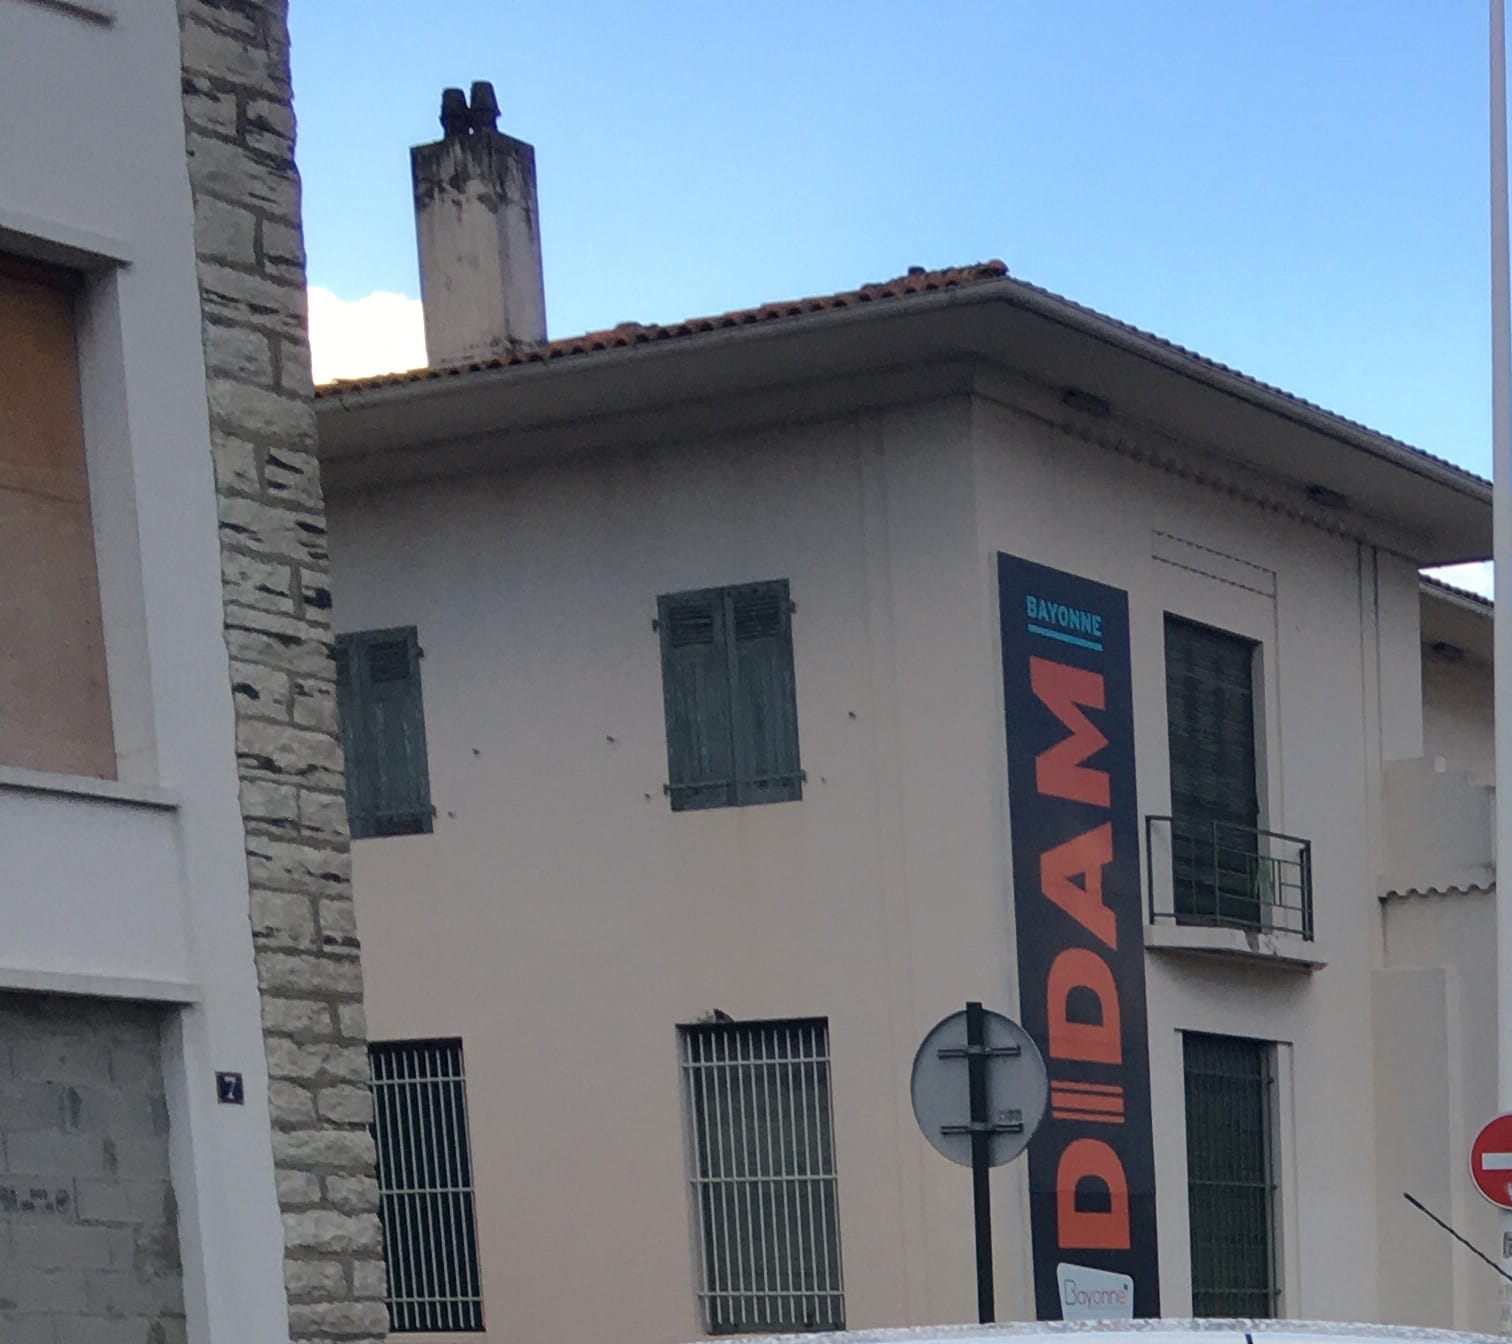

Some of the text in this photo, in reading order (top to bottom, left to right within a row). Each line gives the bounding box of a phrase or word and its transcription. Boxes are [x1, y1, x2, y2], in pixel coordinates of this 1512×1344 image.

[1026, 595, 1102, 637] BAYONNE
[1029, 655, 1131, 1250] DIDAM
[224, 1076, 236, 1099] 7
[1064, 1279, 1128, 1310] Bayonne
